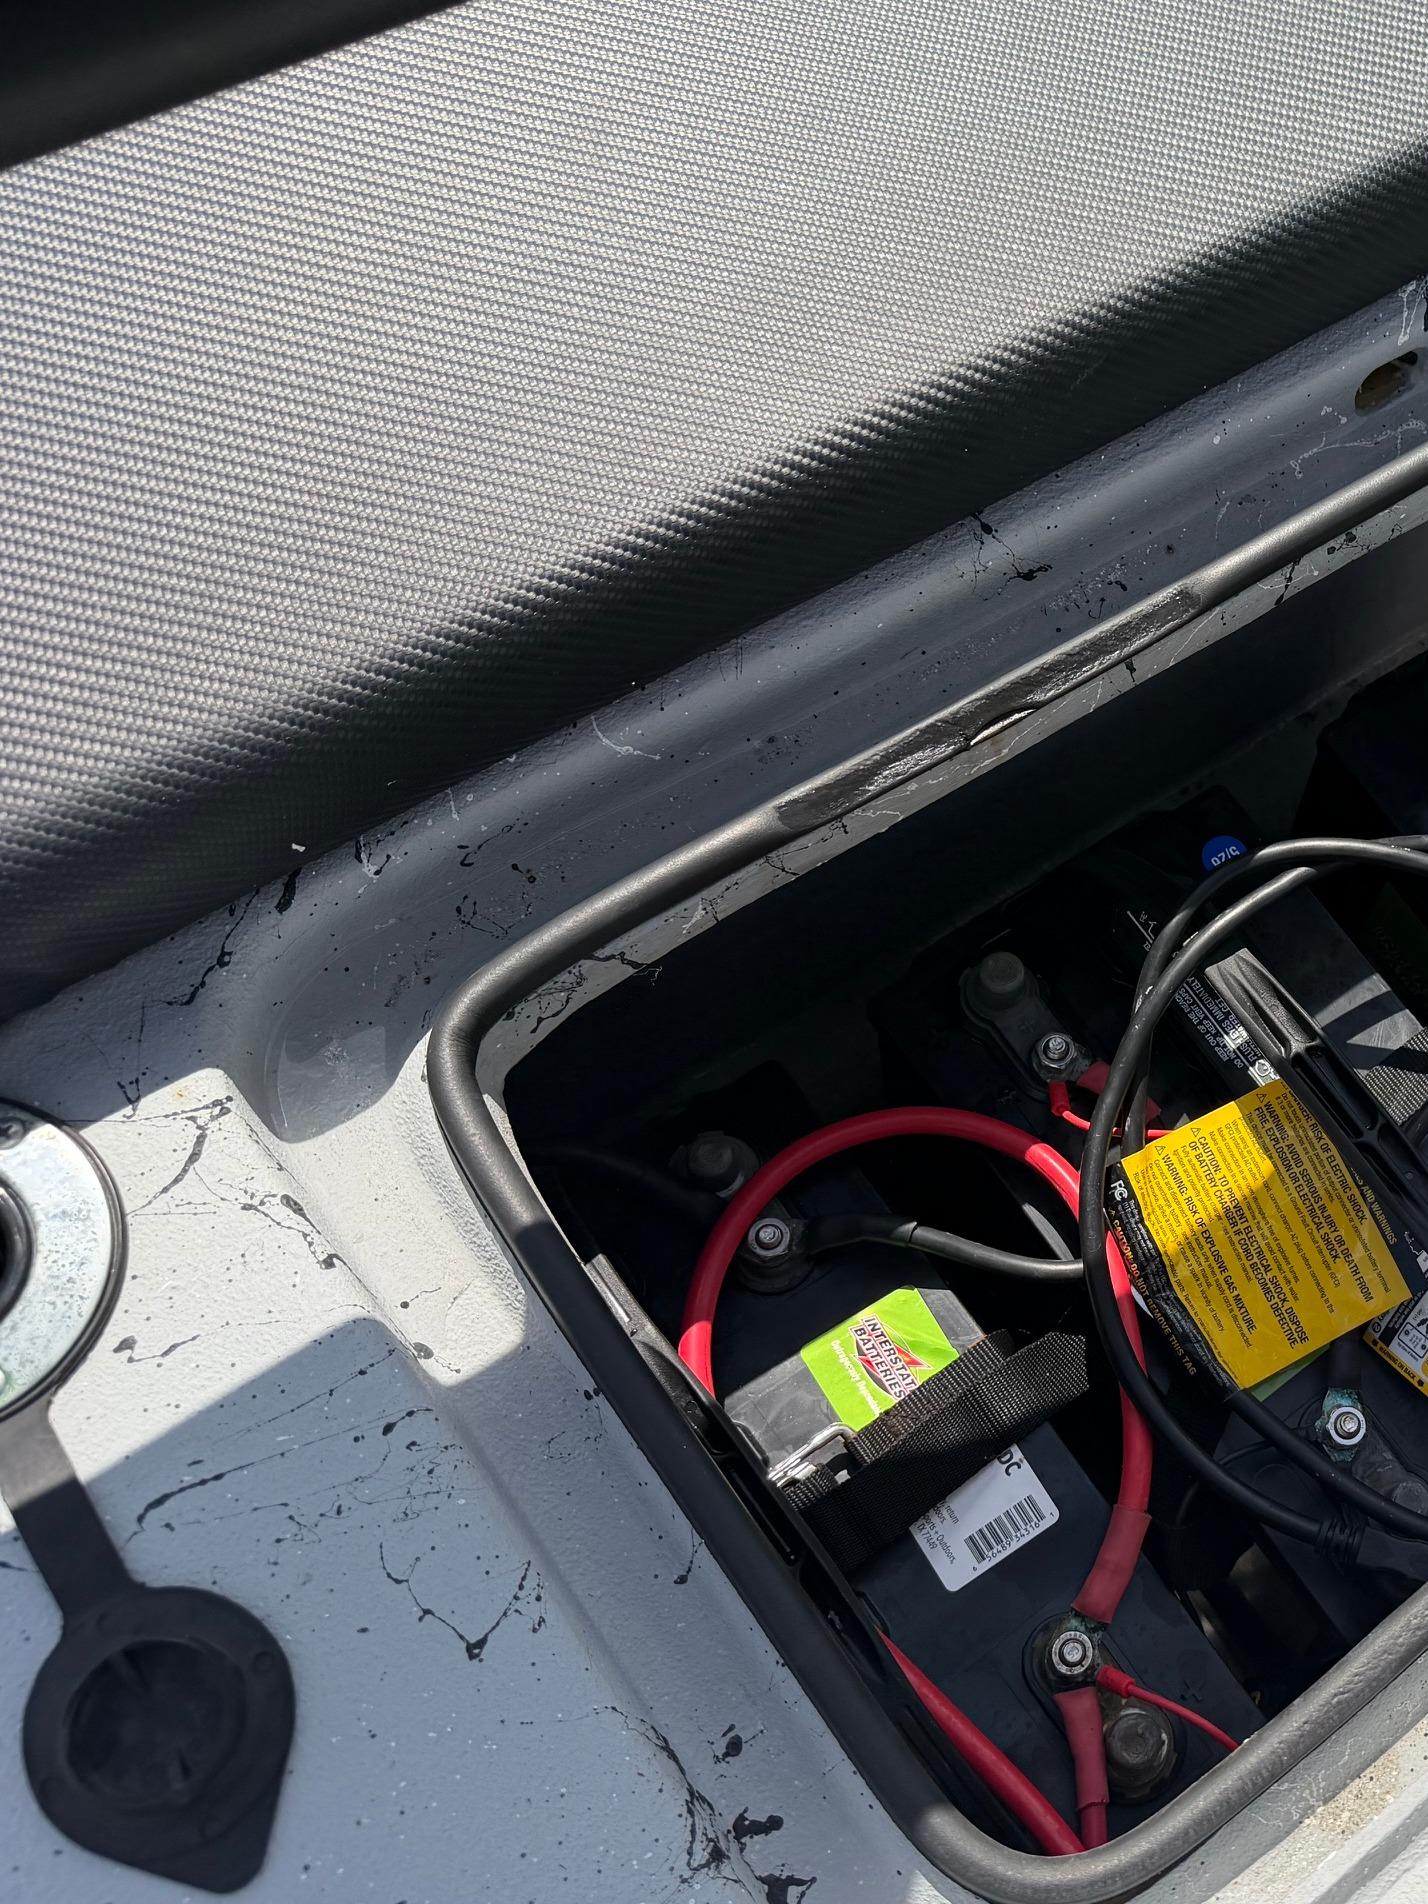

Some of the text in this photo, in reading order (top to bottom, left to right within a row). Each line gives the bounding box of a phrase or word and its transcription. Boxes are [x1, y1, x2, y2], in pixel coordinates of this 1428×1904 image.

[1177, 986, 1193, 1004] CAPS
[1185, 973, 1225, 1021] IMMEDIATELY
[1190, 1002, 1206, 1019] VENT
[1187, 1010, 1200, 1024] THE
[1201, 1017, 1217, 1034] KEEP
[1220, 1018, 1240, 1039] EYES
[1204, 1032, 1217, 1046] OUT
[1213, 1044, 1229, 1061] KEEP
[1223, 1044, 1236, 1059] NOT
[1308, 1122, 1325, 1143] RISK
[1319, 1141, 1332, 1155] OF
[1252, 1106, 1271, 1129] FIRE,
[1264, 1126, 1294, 1172] EXPLOSION
[1287, 1170, 1300, 1185] OR
[1294, 1183, 1325, 1233] ELECTRICAL
[1319, 1231, 1342, 1264] SHOCK.
[1325, 1154, 1352, 1194] ELECTRIC
[1262, 1100, 1374, 1302] WARNING: AVOID SERIOUS INJURY OR DEATH FROM
[1346, 1192, 1368, 1225] SHOCK.
[1361, 1184, 1397, 1245] AND WARNINGS
[1161, 1153, 1258, 1334] WARNING: RISK OF EXPLOSIVE GAS MIXTURE.
[1187, 1140, 1200, 1153] OF
[1194, 1152, 1218, 1189] BATTERY
[1212, 1188, 1239, 1229] CHARGER
[1236, 1237, 1255, 1262] CORD
[1248, 1261, 1275, 1302] BECOMES
[1269, 1301, 1299, 1349] DEFECTIVE.
[1196, 1135, 1309, 1344] CAUTION: TO PREVENT ELECTRICAL SHOCK, DISPOSE
[1135, 1277, 1151, 1297] NOT
[1145, 1297, 1172, 1335] REMOVE
[1167, 1334, 1185, 1356] THIS
[1180, 1355, 1197, 1375] TAG
[853, 1325, 905, 1399] BATTERIES
[864, 1316, 918, 1392] INTERSTAT
[921, 1512, 937, 1531] ports
[985, 1538, 1012, 1561] 56489
[1013, 1520, 1041, 1542] 34316
